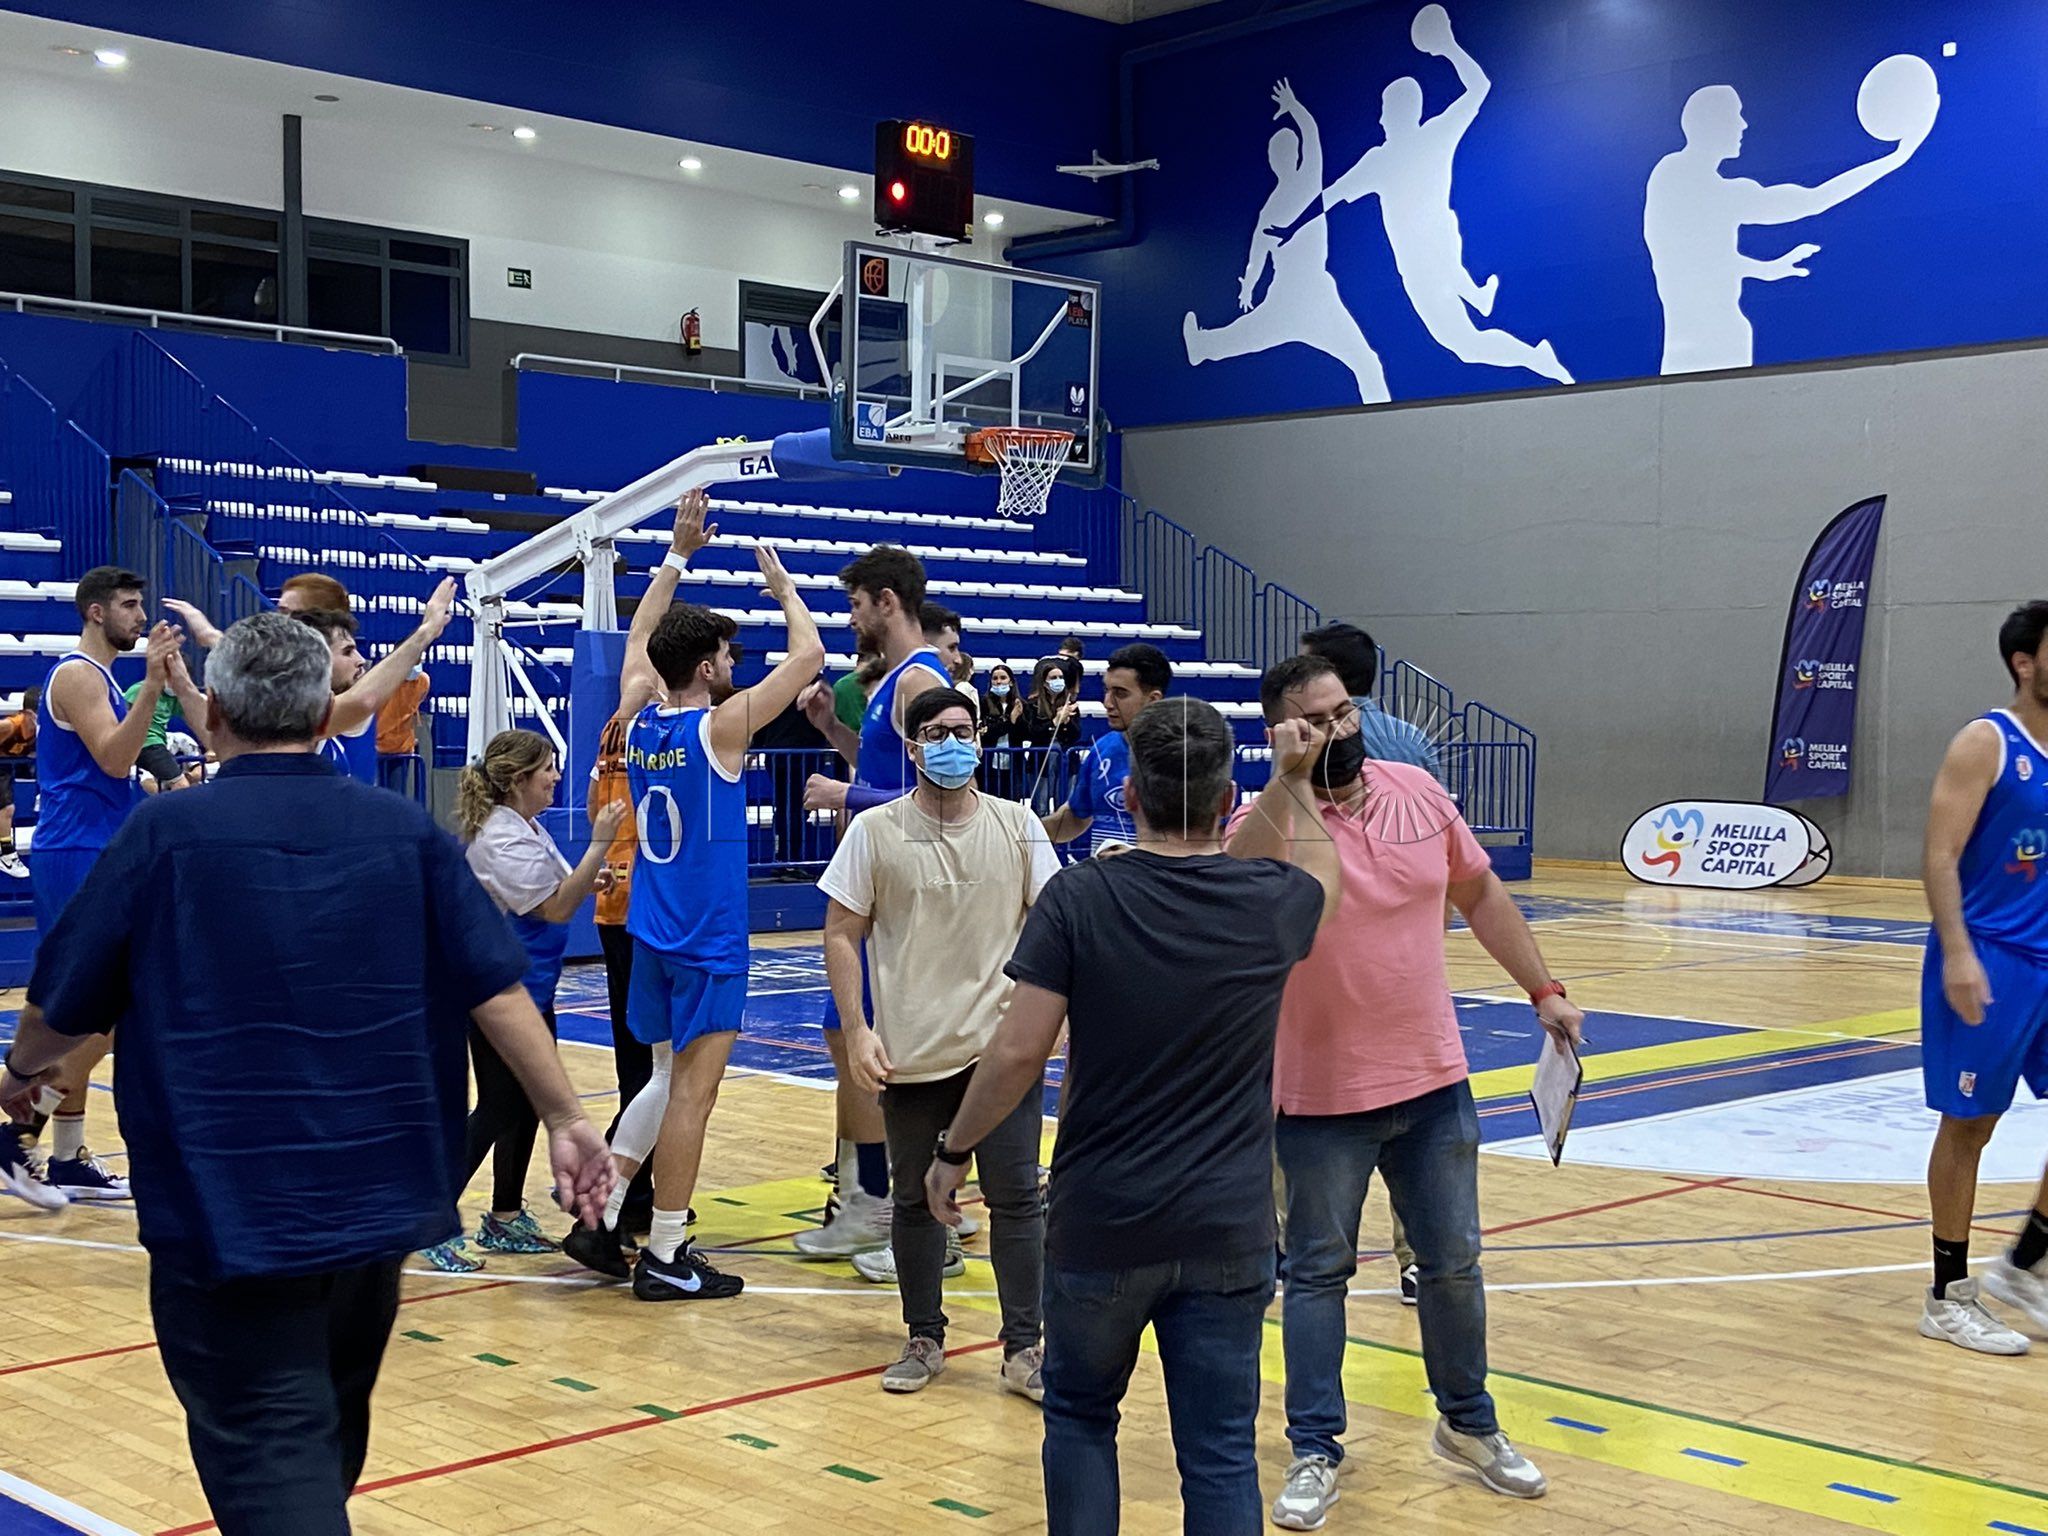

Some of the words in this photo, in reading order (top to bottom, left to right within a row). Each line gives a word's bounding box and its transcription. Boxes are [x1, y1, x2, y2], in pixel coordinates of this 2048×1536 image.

[859, 427, 879, 439] EBA
[1808, 743, 1847, 753] MELILLA
[1808, 752, 1841, 761] SPORT
[1807, 760, 1847, 770] CAPITAL
[636, 785, 683, 864] 0
[1711, 823, 1787, 842] MELILLA
[1705, 840, 1770, 859] SPORT
[1700, 857, 1776, 878] CAPITAL
